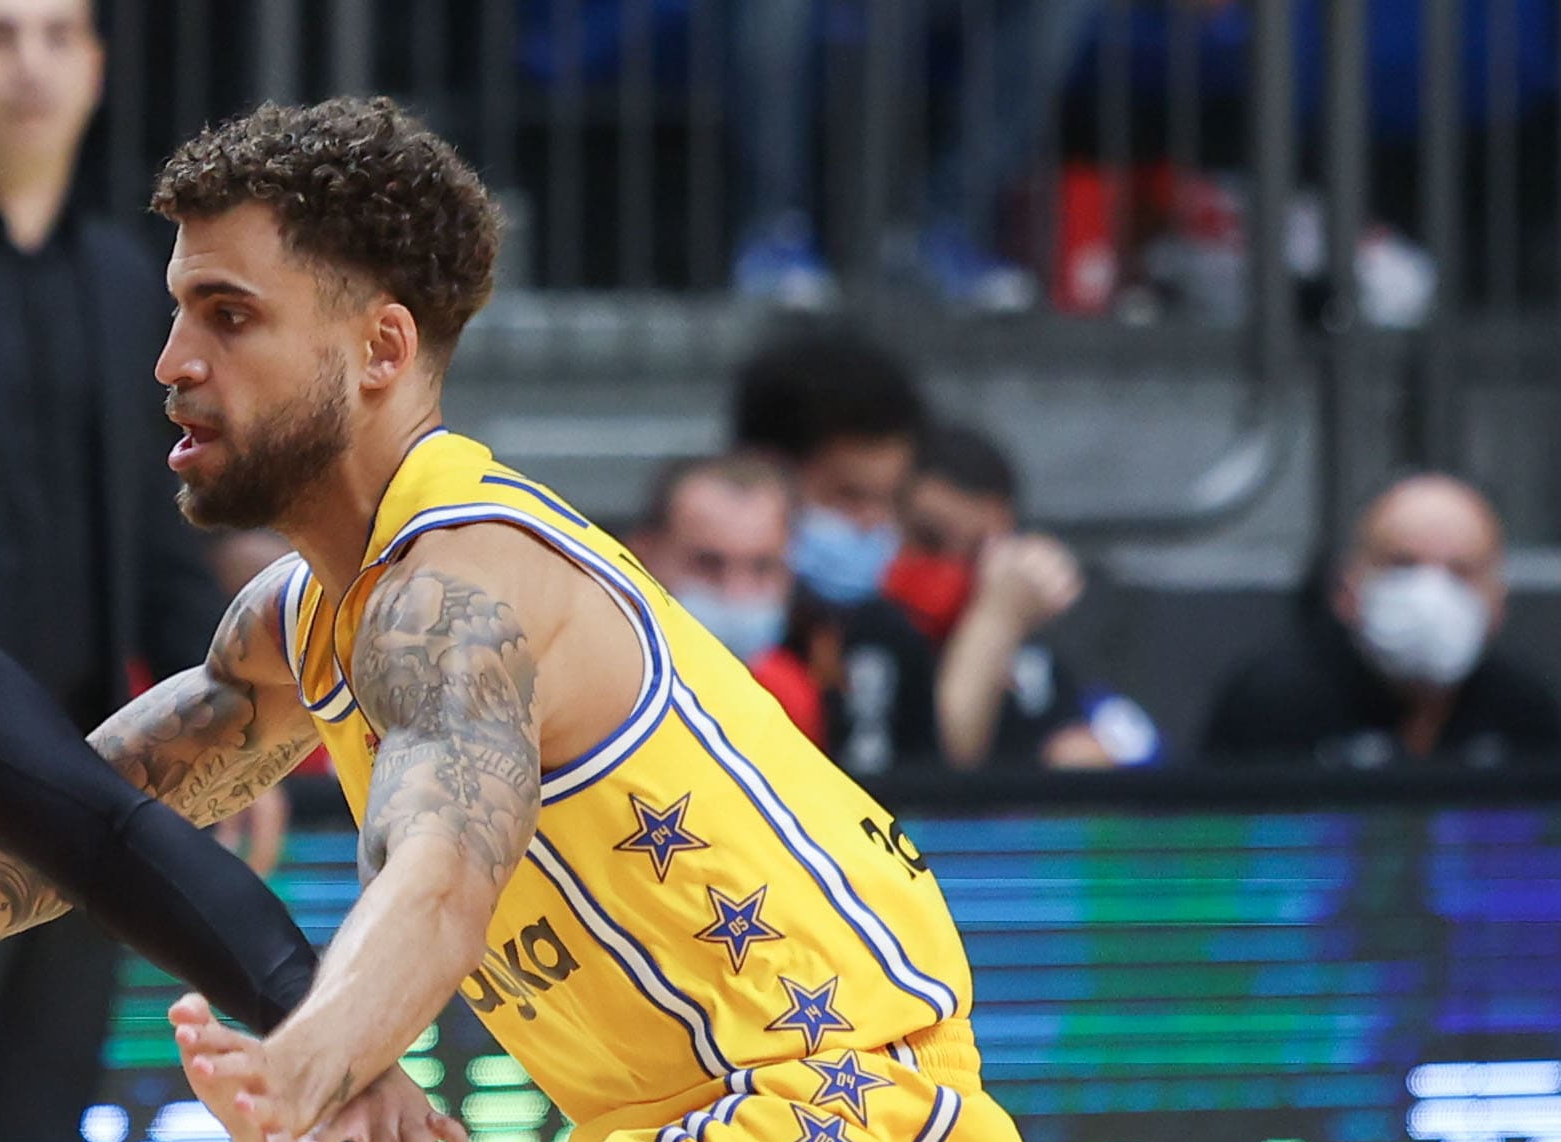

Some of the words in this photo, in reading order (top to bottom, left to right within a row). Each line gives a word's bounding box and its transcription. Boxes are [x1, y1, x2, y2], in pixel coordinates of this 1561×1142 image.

[650, 824, 672, 846] 04
[727, 917, 749, 936] 05
[804, 1006, 821, 1023] 14
[835, 1071, 857, 1091] 04
